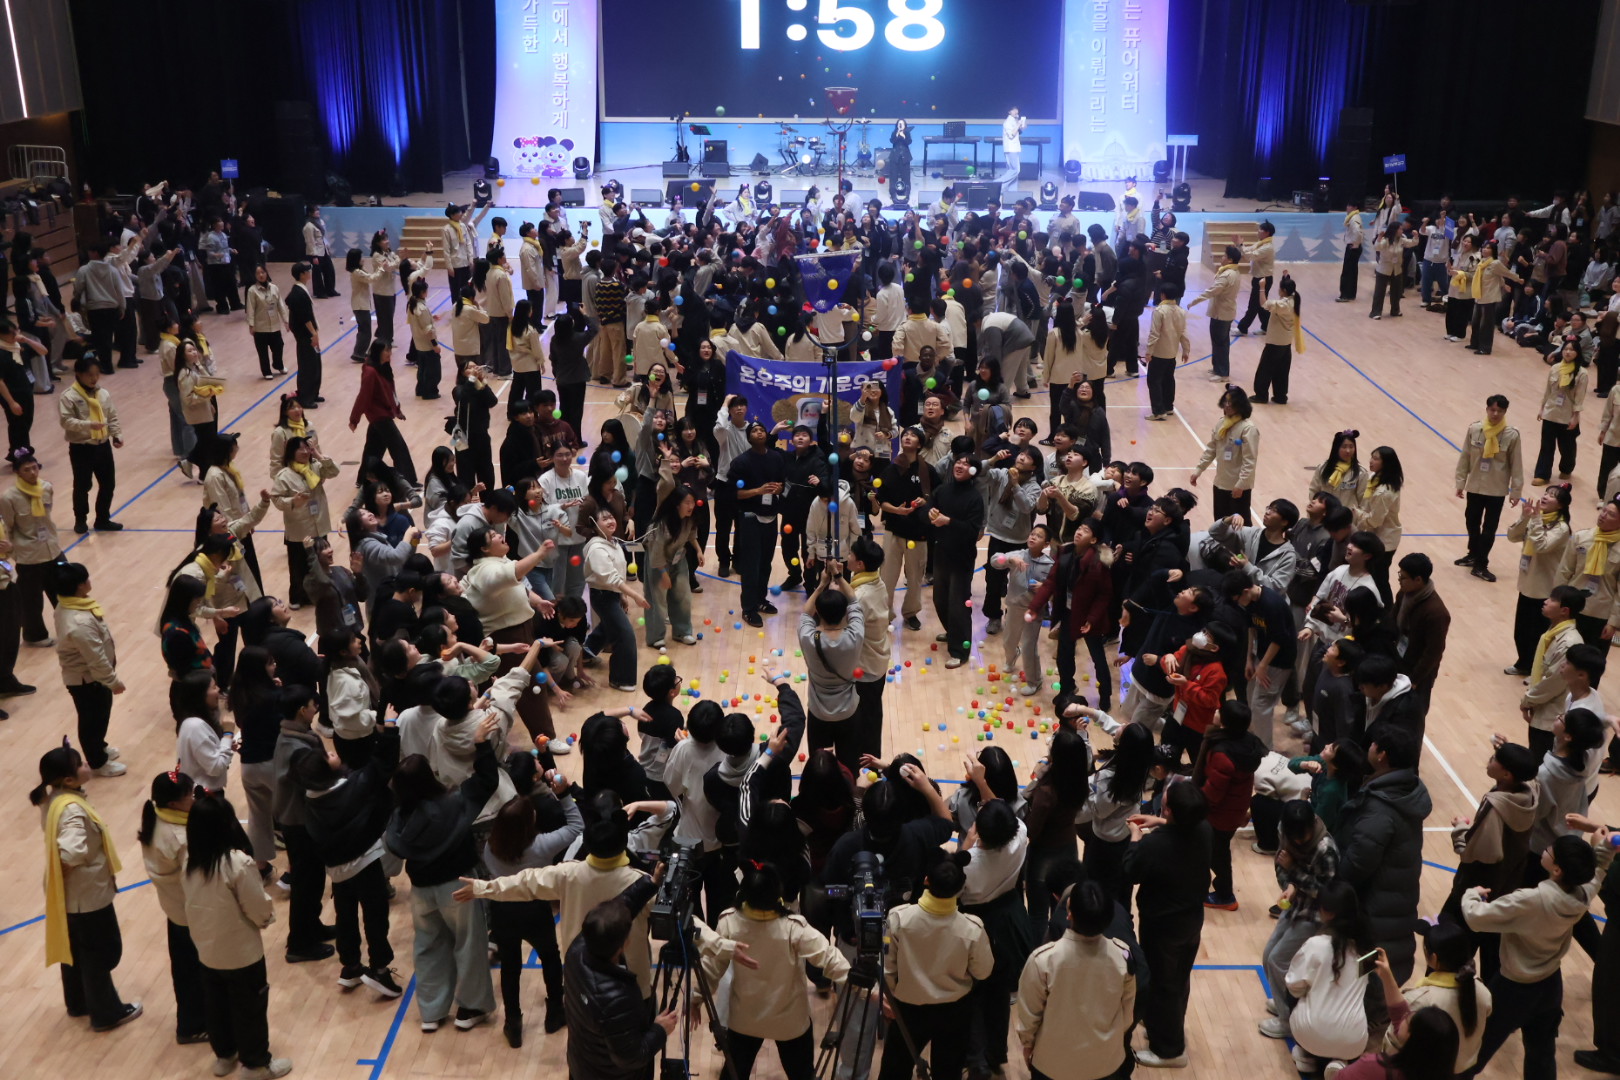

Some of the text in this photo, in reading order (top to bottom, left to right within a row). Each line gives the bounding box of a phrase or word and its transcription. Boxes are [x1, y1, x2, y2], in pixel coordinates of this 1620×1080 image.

[740, 0, 945, 51] 1:58
[552, 1, 569, 129] 에서 행복하게
[1090, 37, 1108, 133] 이뤄드리는
[739, 365, 810, 394] 온우주의
